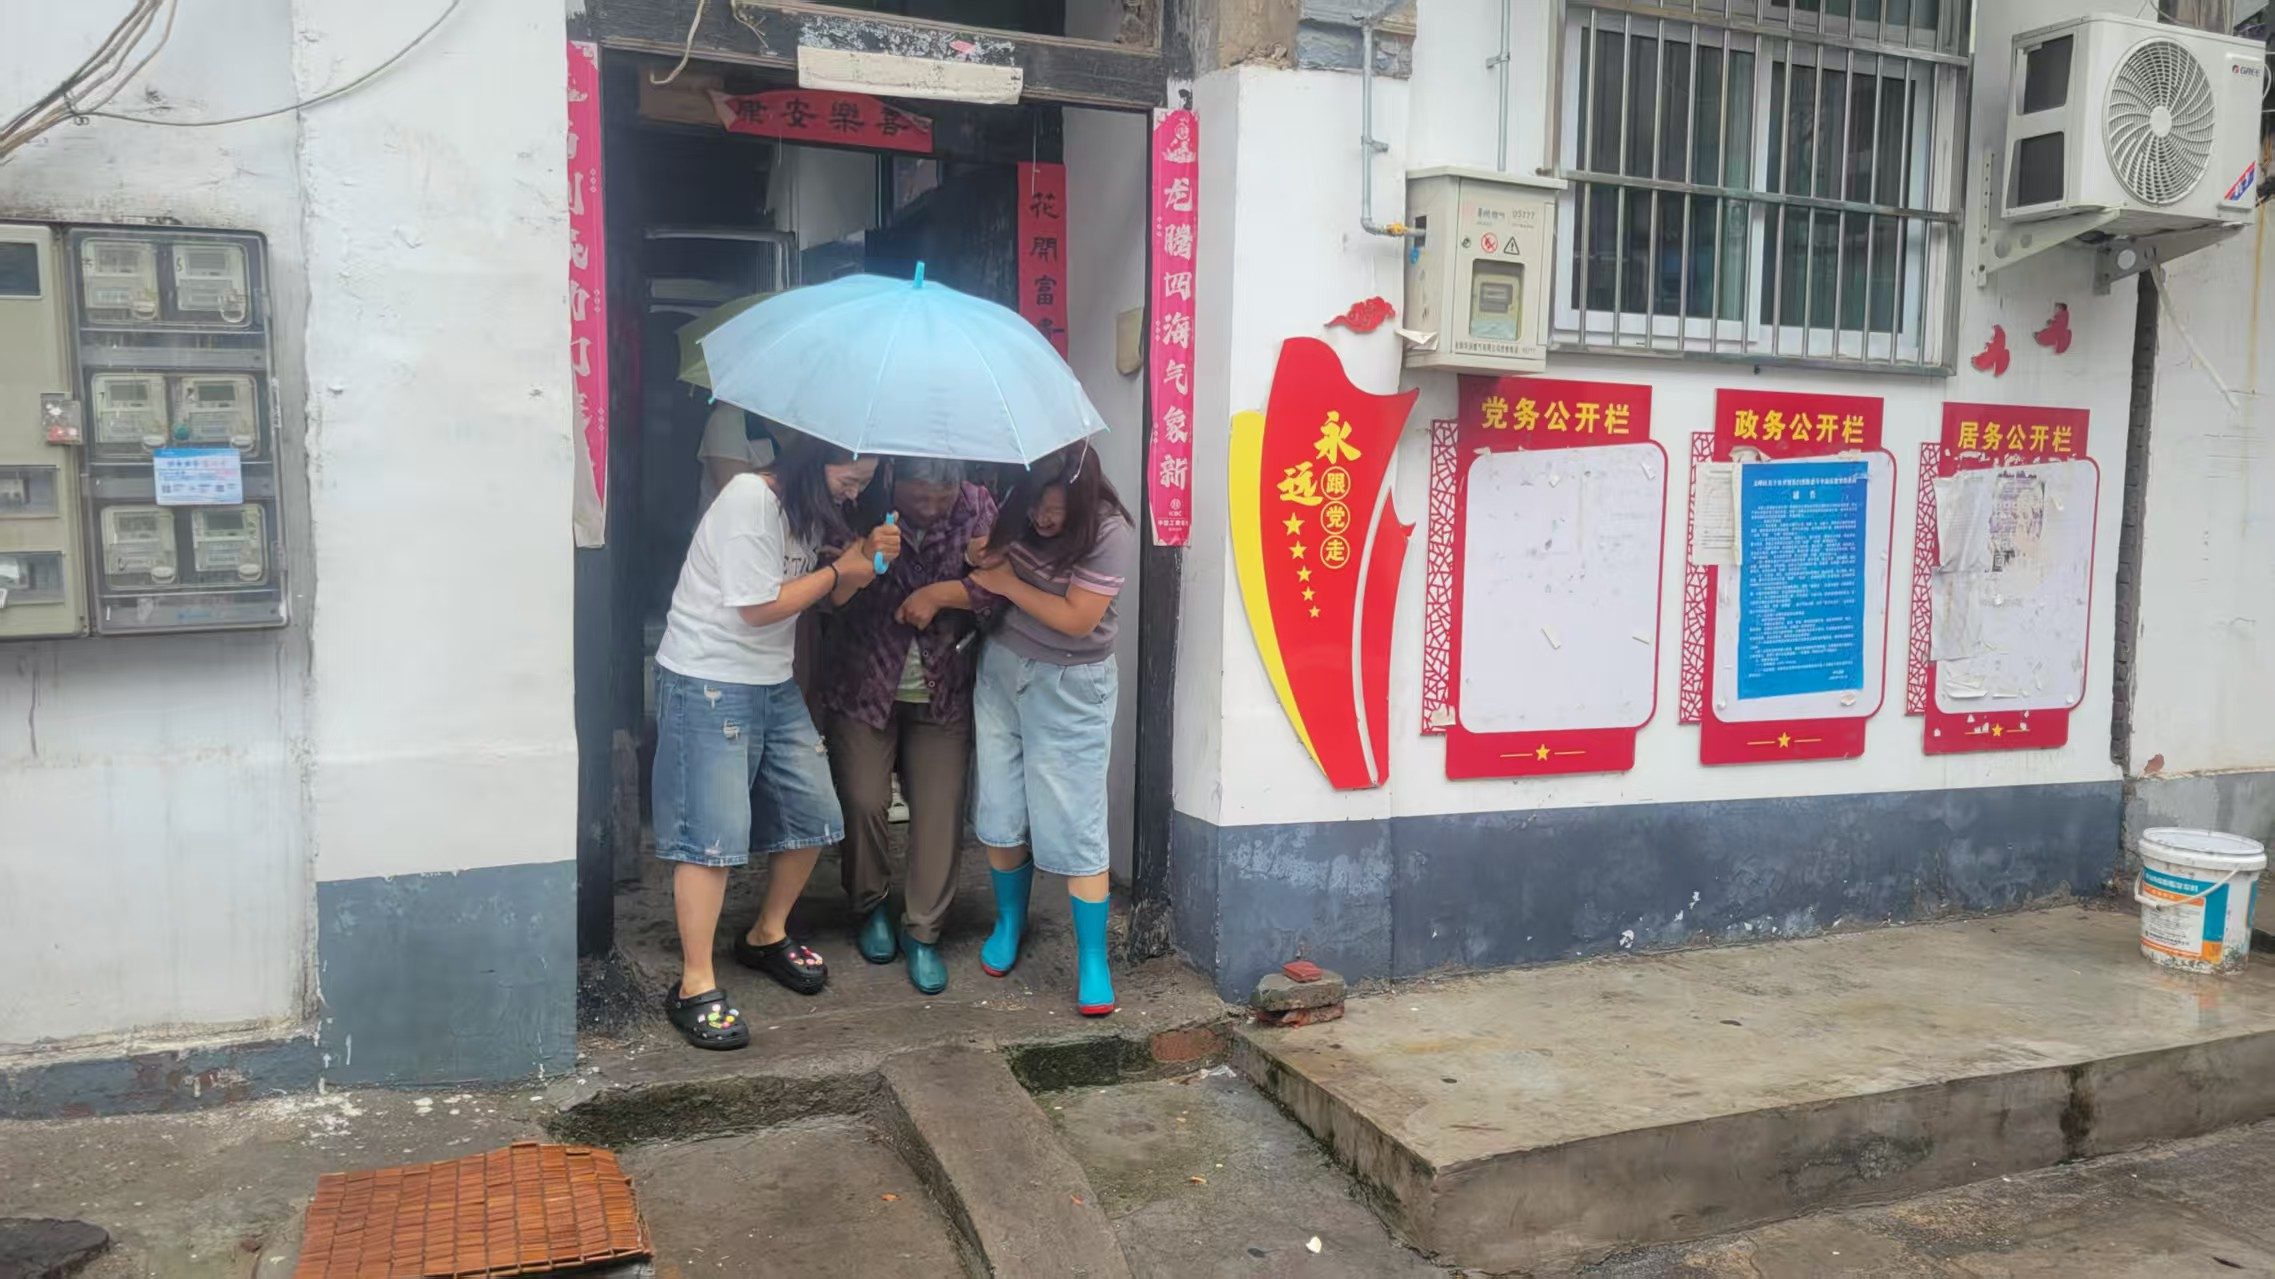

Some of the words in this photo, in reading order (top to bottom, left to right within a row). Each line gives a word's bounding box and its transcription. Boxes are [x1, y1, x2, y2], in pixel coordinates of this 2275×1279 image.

[1481, 396, 1629, 434] 党务公开栏
[1734, 409, 1864, 443] 政务公开栏
[1958, 421, 2072, 452] 居务公开栏
